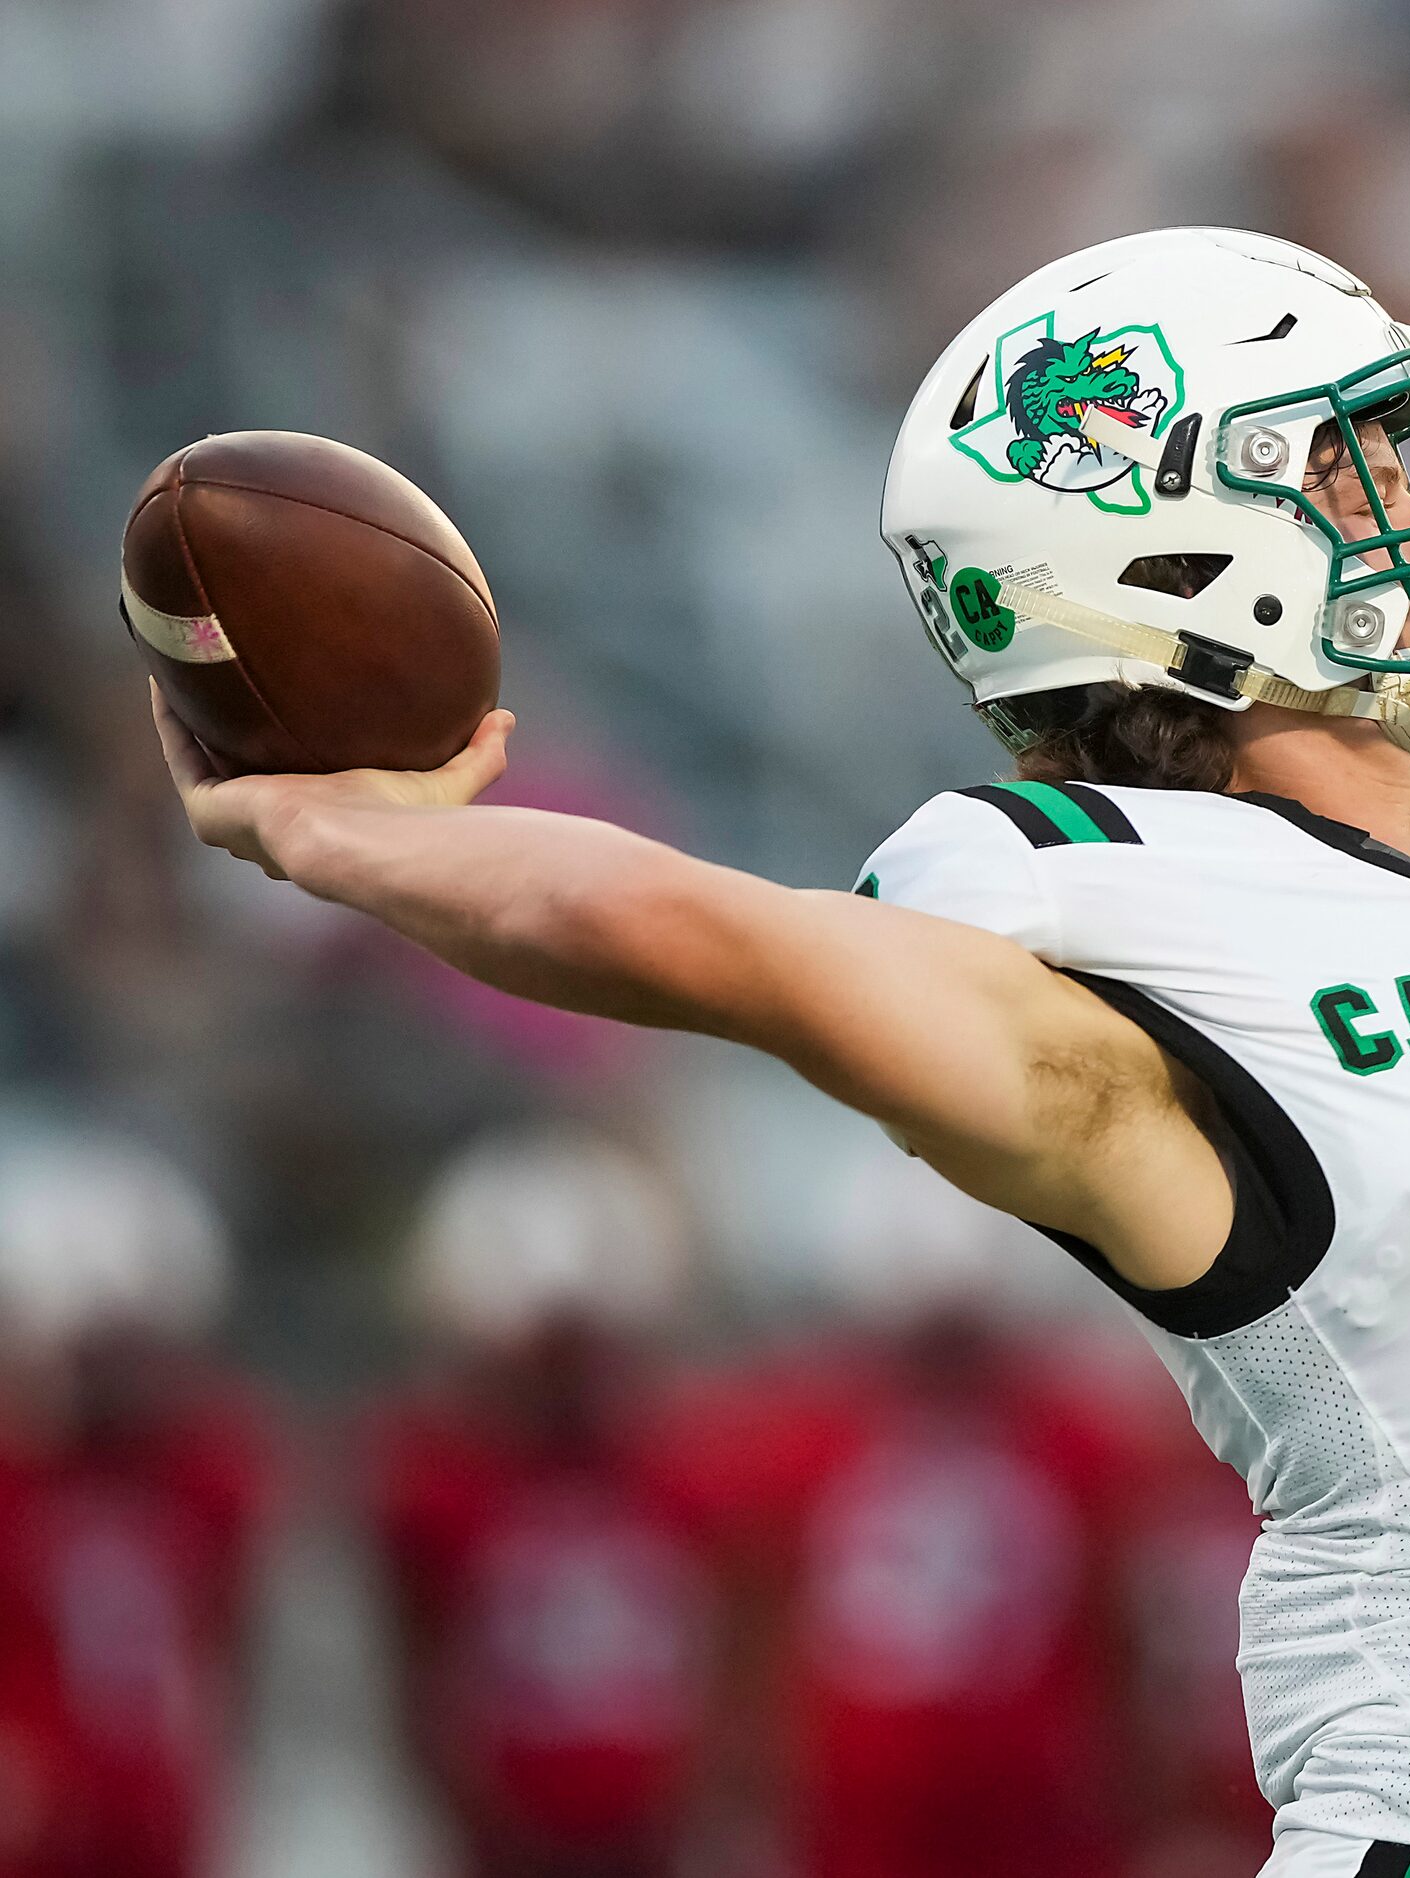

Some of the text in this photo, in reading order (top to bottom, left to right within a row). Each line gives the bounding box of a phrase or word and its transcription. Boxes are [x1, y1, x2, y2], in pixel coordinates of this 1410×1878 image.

[989, 564, 1014, 578] RNING
[955, 579, 1000, 624] CA
[975, 620, 1008, 646] CAPPY
